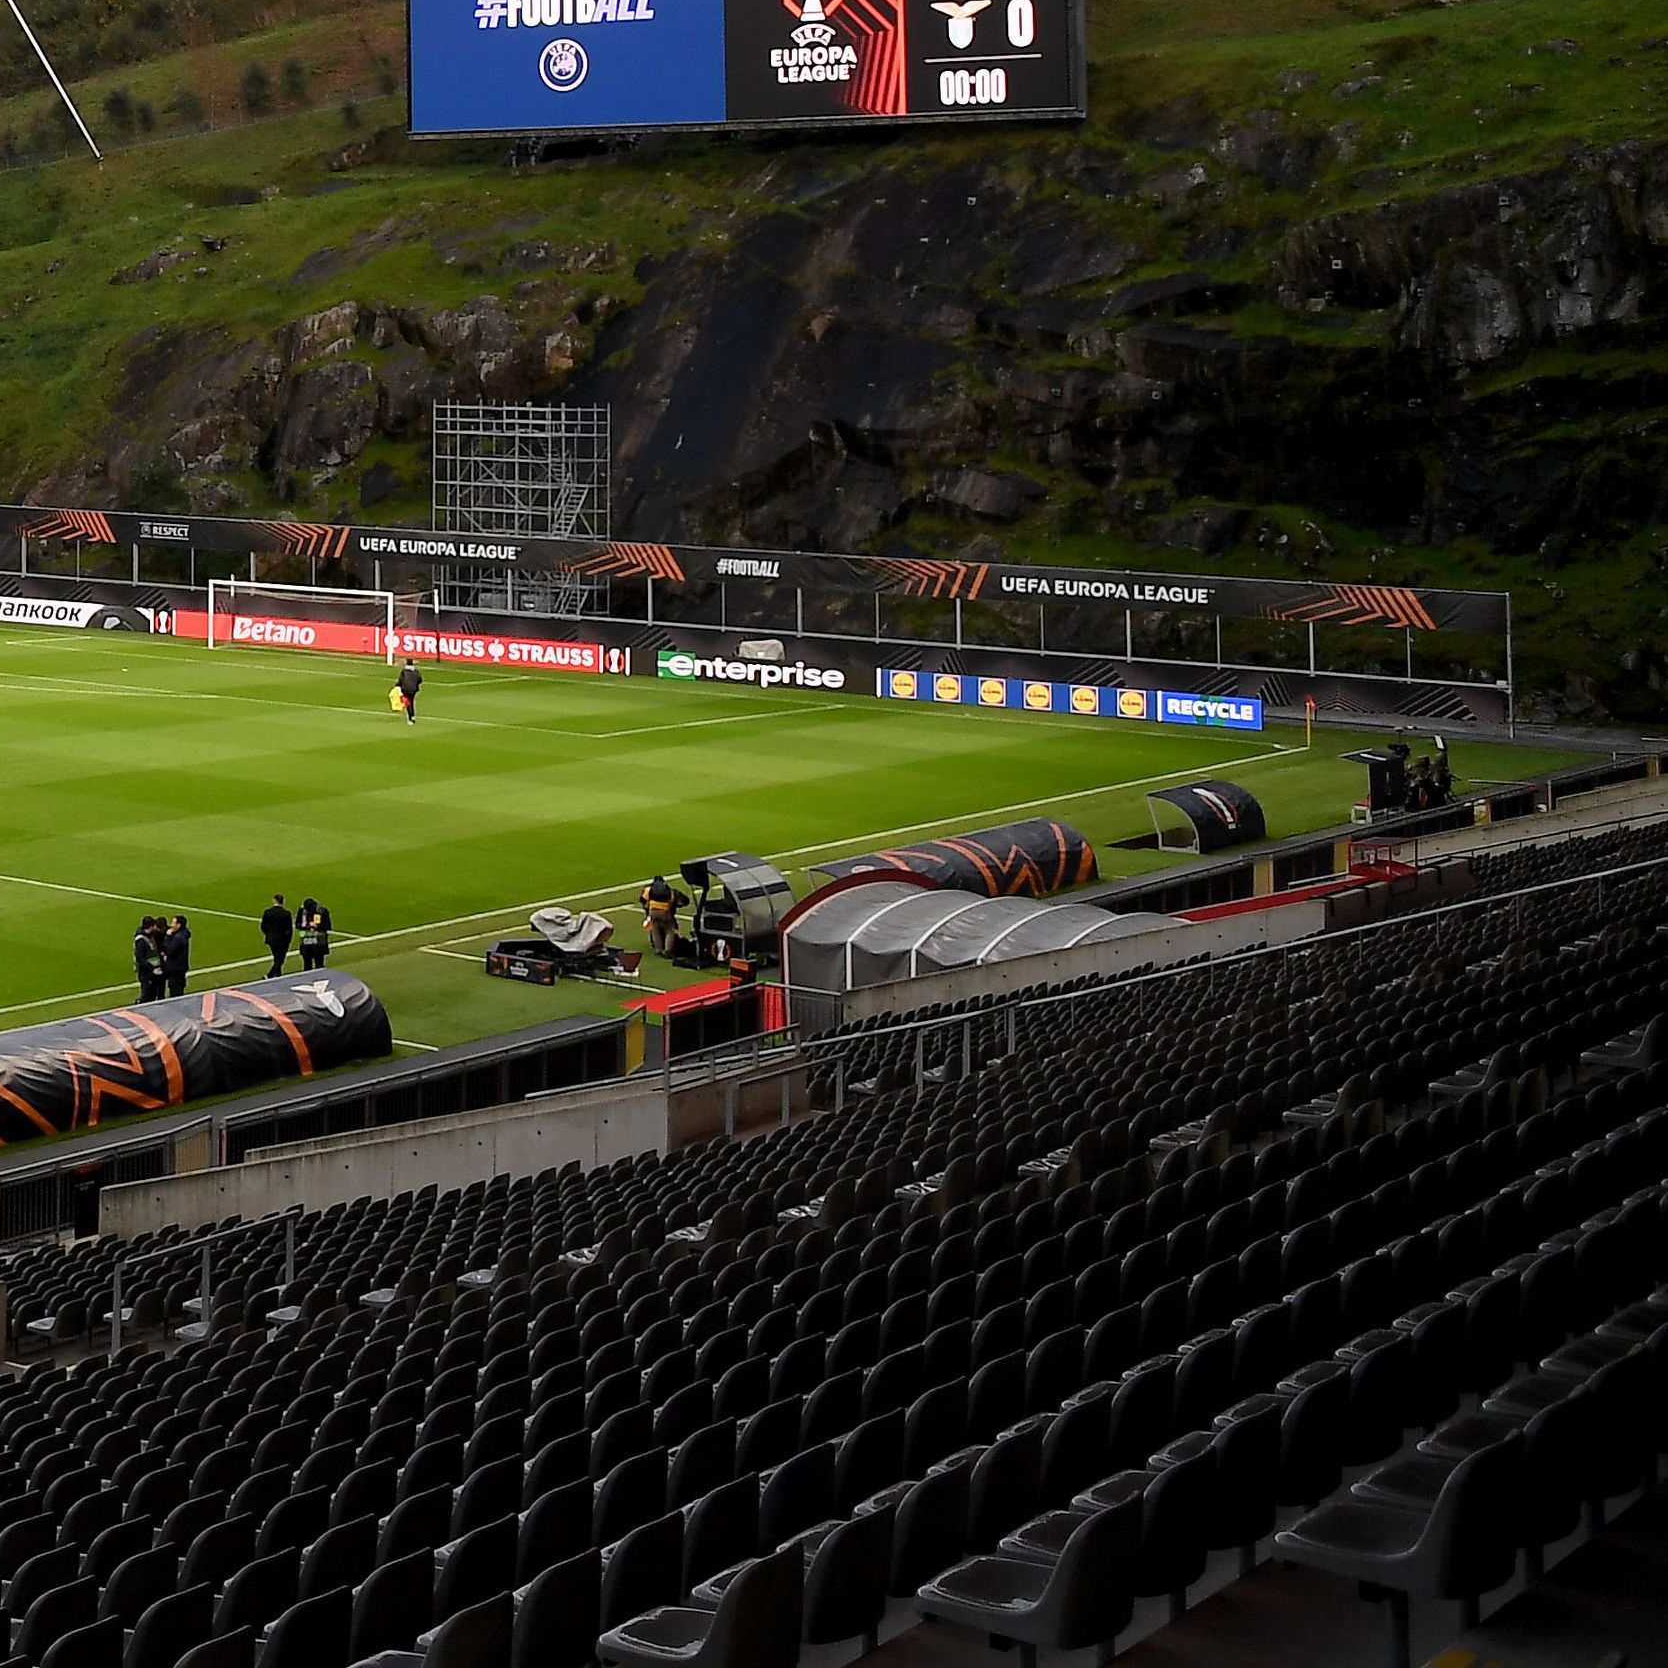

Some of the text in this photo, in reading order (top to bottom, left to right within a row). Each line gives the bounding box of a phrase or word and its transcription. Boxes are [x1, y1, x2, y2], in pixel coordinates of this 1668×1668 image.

[793, 26, 832, 46] UEFA
[770, 45, 858, 68] EUROPA
[777, 64, 851, 84] LEAGUE
[939, 68, 1006, 106] 00:00
[152, 525, 189, 537] RESPECT
[360, 537, 518, 561] UEFA EUROPA LEAGUE
[716, 557, 779, 579] #FOOTBALL
[1001, 575, 1210, 605] UEFA EUROPA LEAGUE
[233, 616, 316, 646] Betano
[402, 633, 595, 667] STRAUSS STRAUSS
[668, 654, 845, 689] enterprise
[1167, 697, 1254, 721] RECYCLE
